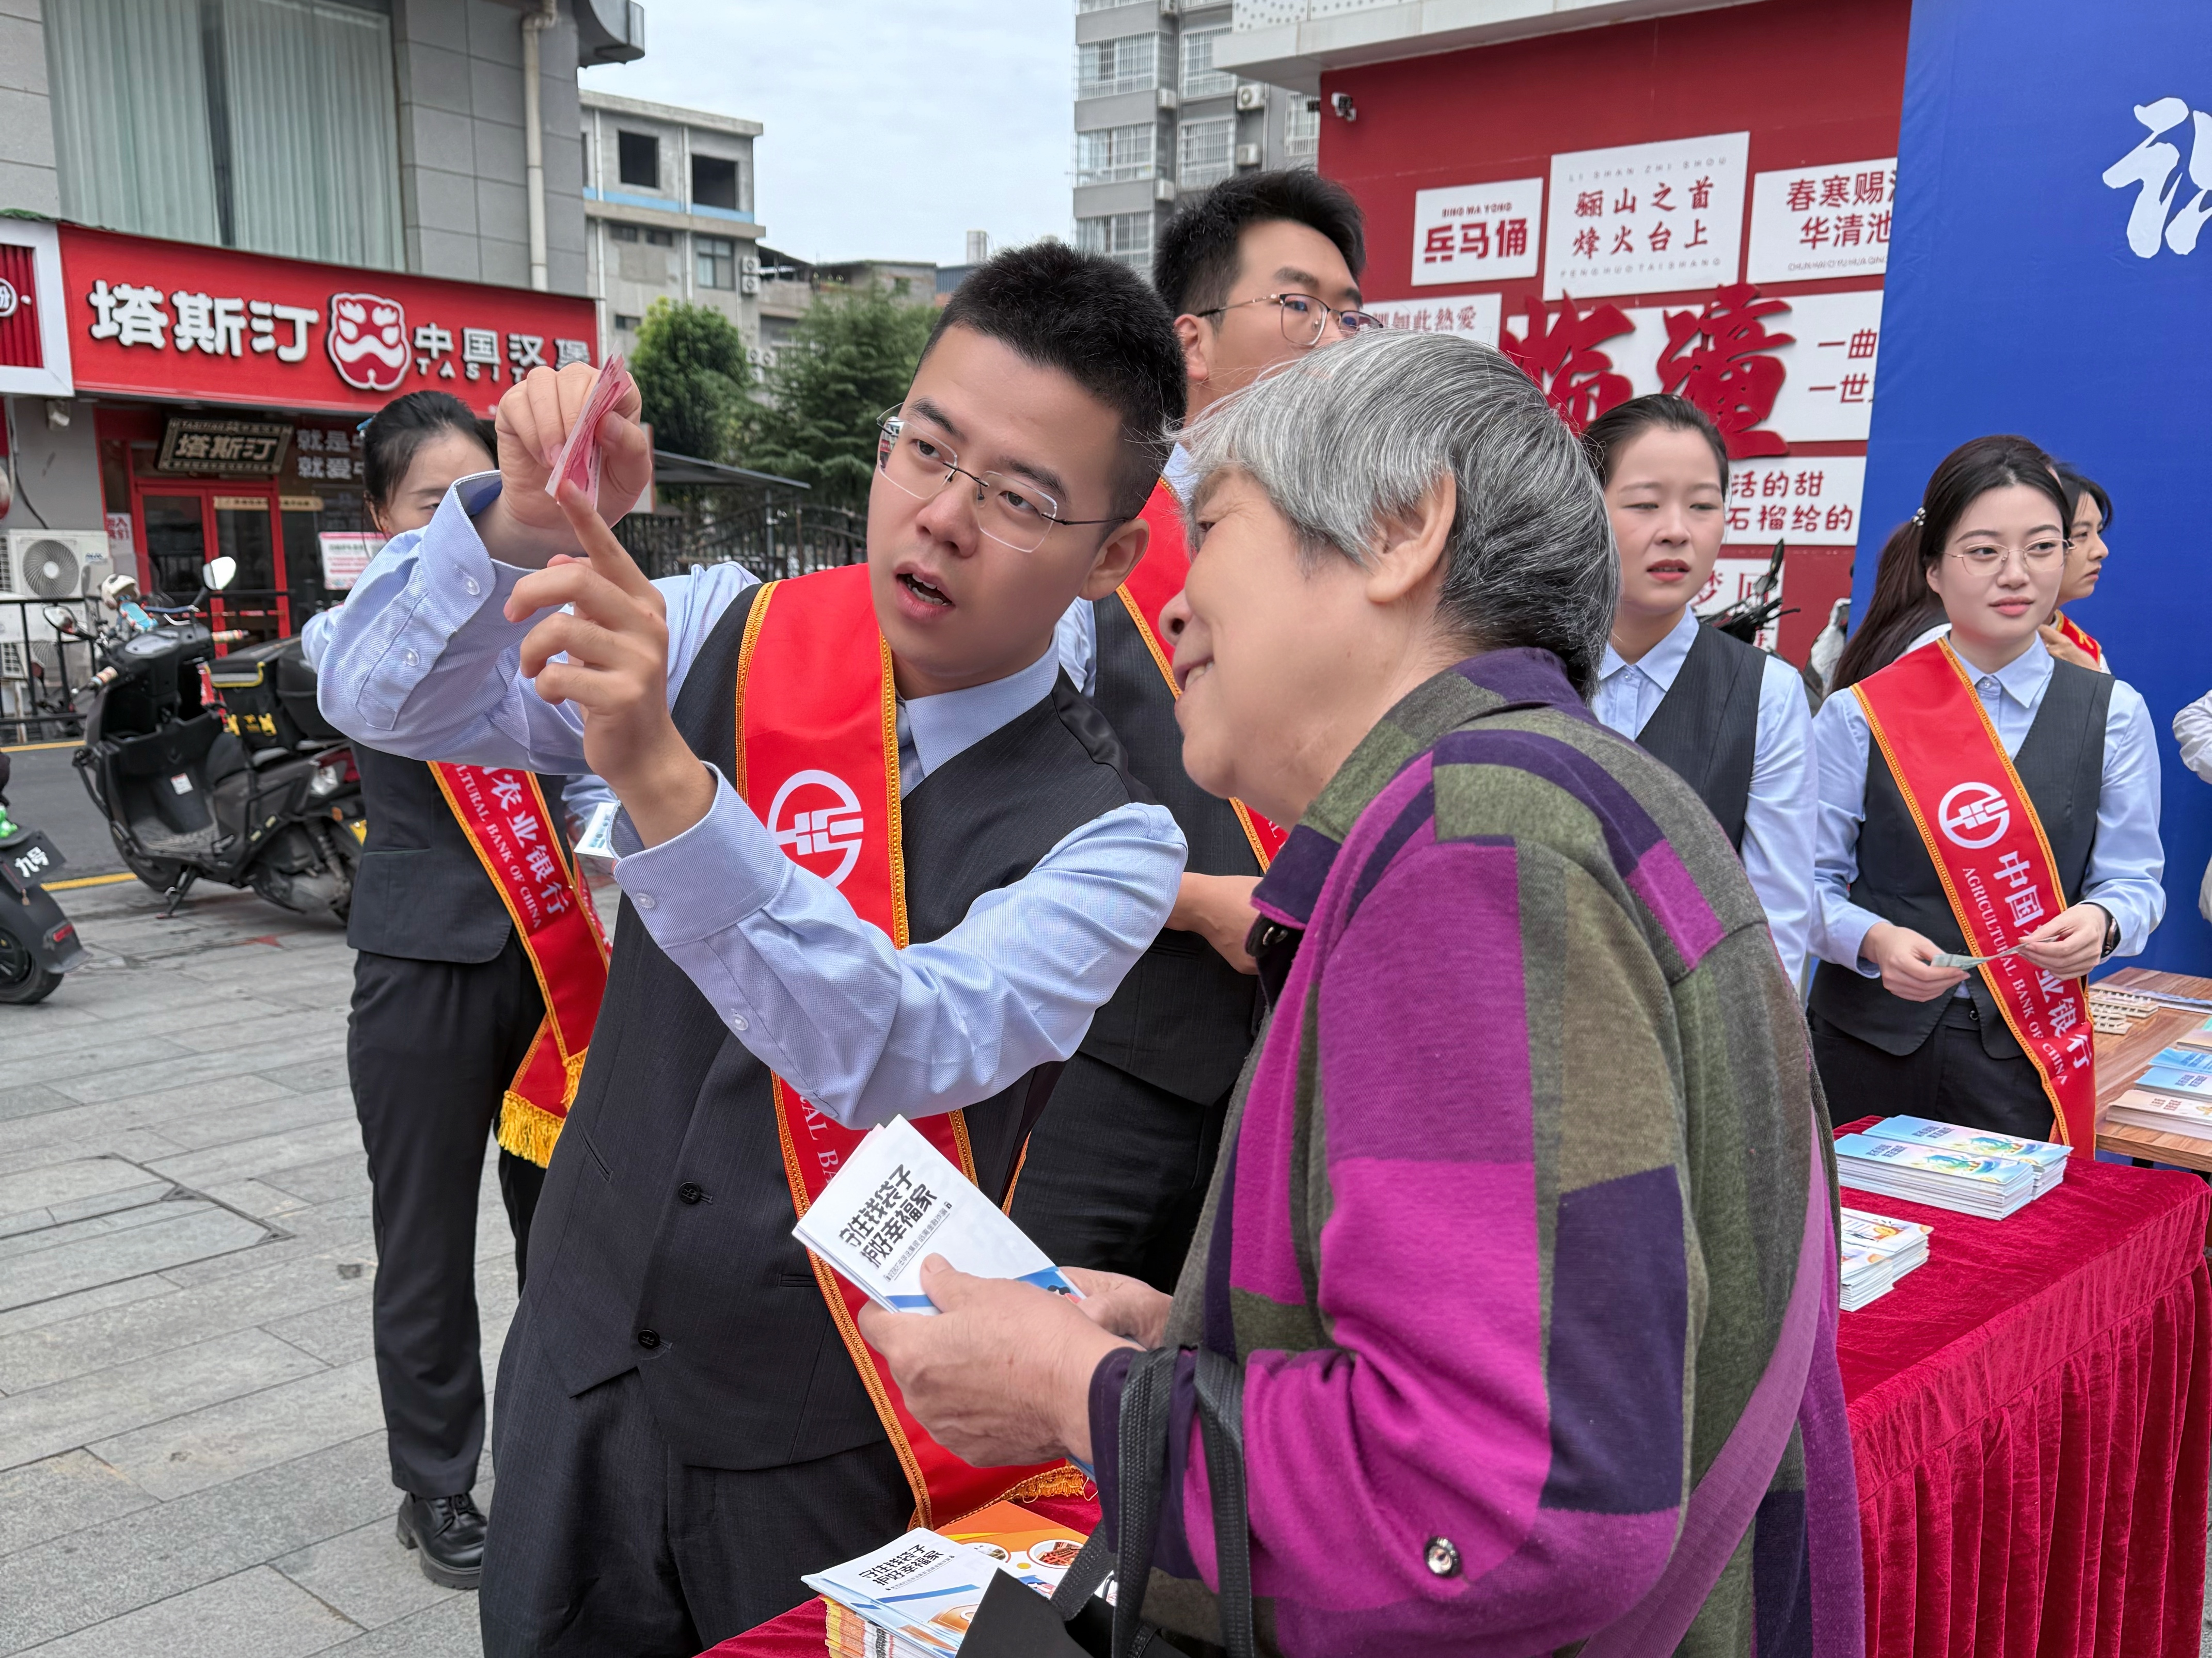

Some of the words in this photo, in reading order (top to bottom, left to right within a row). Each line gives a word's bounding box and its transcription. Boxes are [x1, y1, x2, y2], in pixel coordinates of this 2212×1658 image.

[1574, 176, 1714, 217] 骊山之首
[1424, 218, 1528, 264] 兵马俑
[1572, 218, 1708, 260] 烽火台上
[1799, 210, 1891, 250] 华清池
[89, 279, 320, 362] 塔斯汀
[414, 322, 591, 370] 中国汉堡
[1818, 328, 1877, 359] 一曲
[1809, 373, 1874, 403] 一世
[176, 433, 277, 460] 塔斯汀
[1726, 504, 1853, 532] 石榴给的
[482, 767, 569, 914] 农业银行
[14, 846, 50, 878] 九号
[486, 823, 515, 863] BANK
[510, 865, 525, 883] OF
[520, 886, 542, 929] CHINA
[1994, 850, 2092, 1069] 中国业银行
[2012, 979, 2035, 1019] BANK
[2029, 1021, 2044, 1039] OF
[2042, 1042, 2068, 1086] CHINA
[838, 1163, 912, 1247] 守住钱袋子
[860, 1183, 938, 1269] 护好幸福家
[858, 1544, 925, 1580] 守住钱袋子
[873, 1550, 944, 1586] 护好幸福家
